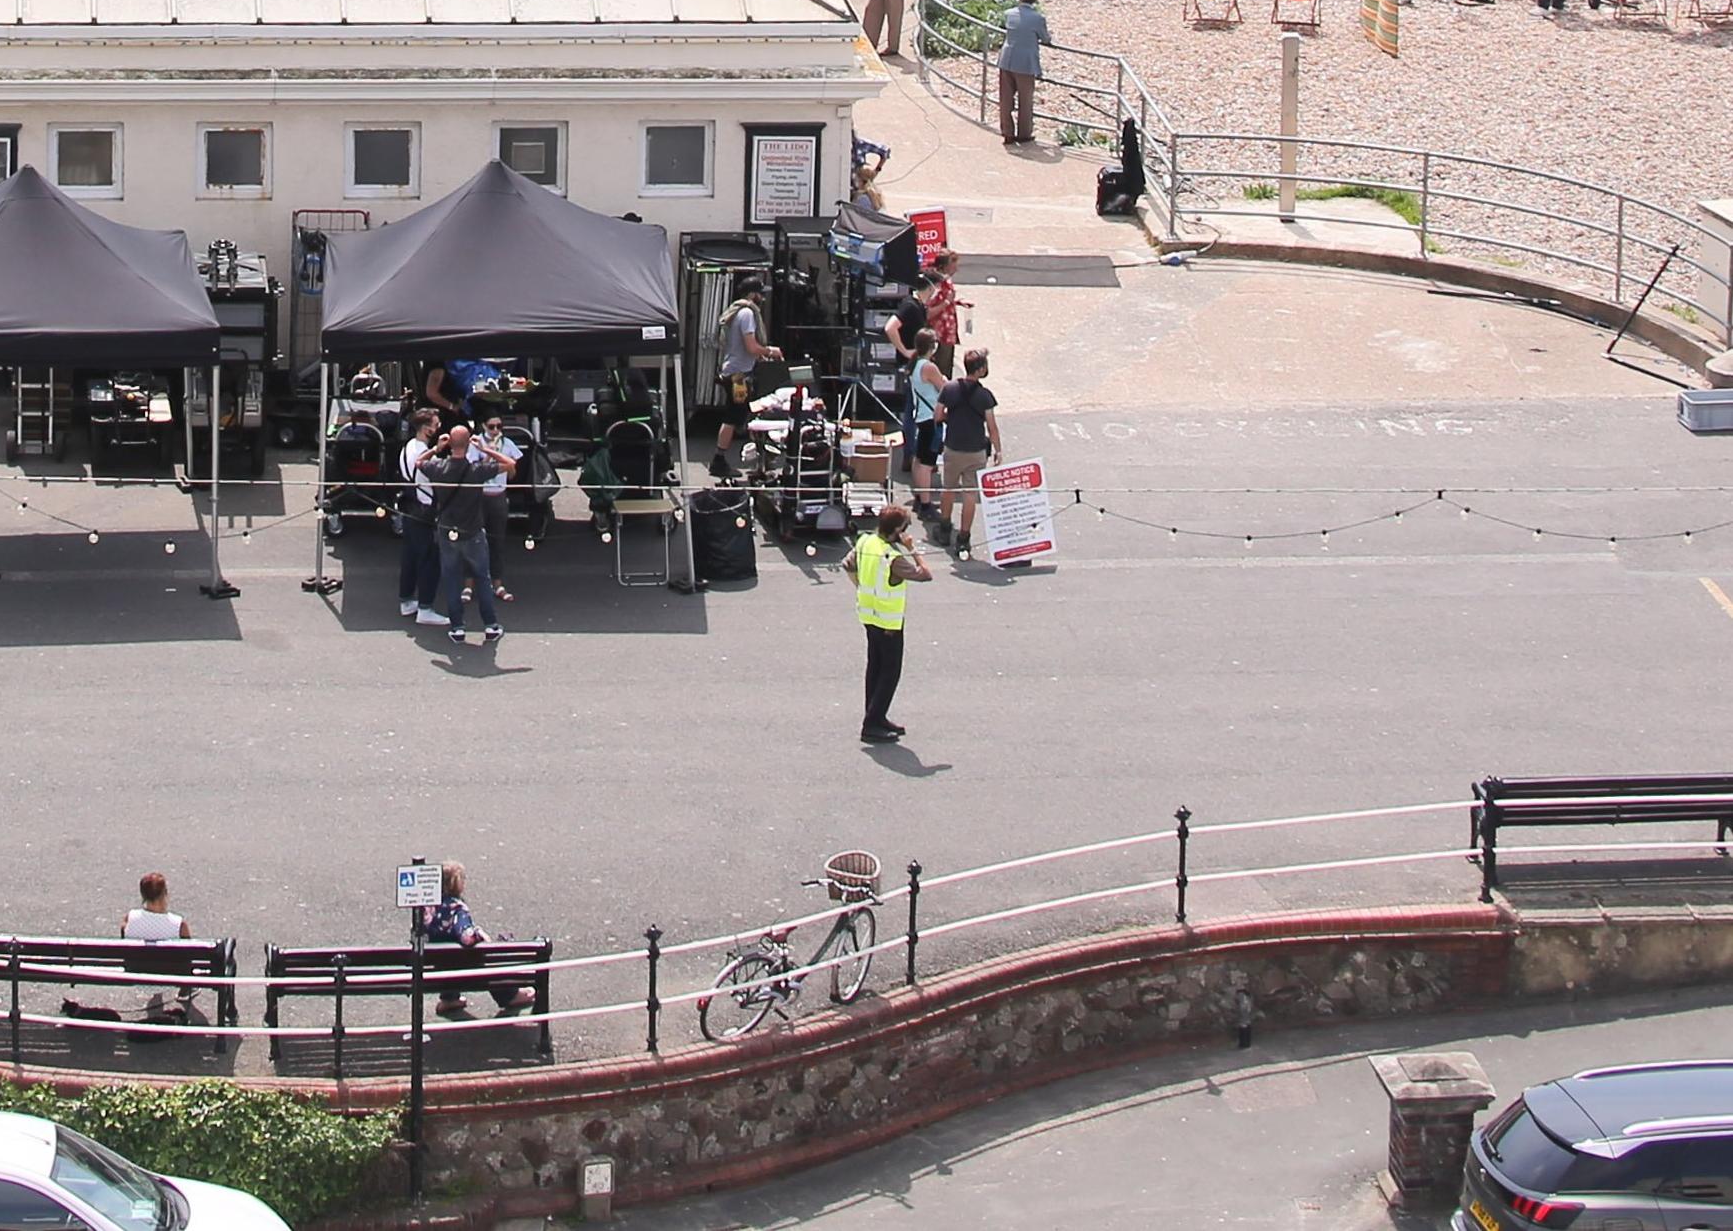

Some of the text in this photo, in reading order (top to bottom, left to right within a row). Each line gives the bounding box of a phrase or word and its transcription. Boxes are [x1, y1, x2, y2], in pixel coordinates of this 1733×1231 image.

[918, 230, 938, 241] RED
[917, 242, 942, 255] ZONE
[1047, 421, 1138, 442] NO
[986, 464, 1036, 482] PUBLIC NOTICE
[994, 474, 1030, 488] FILMING IN
